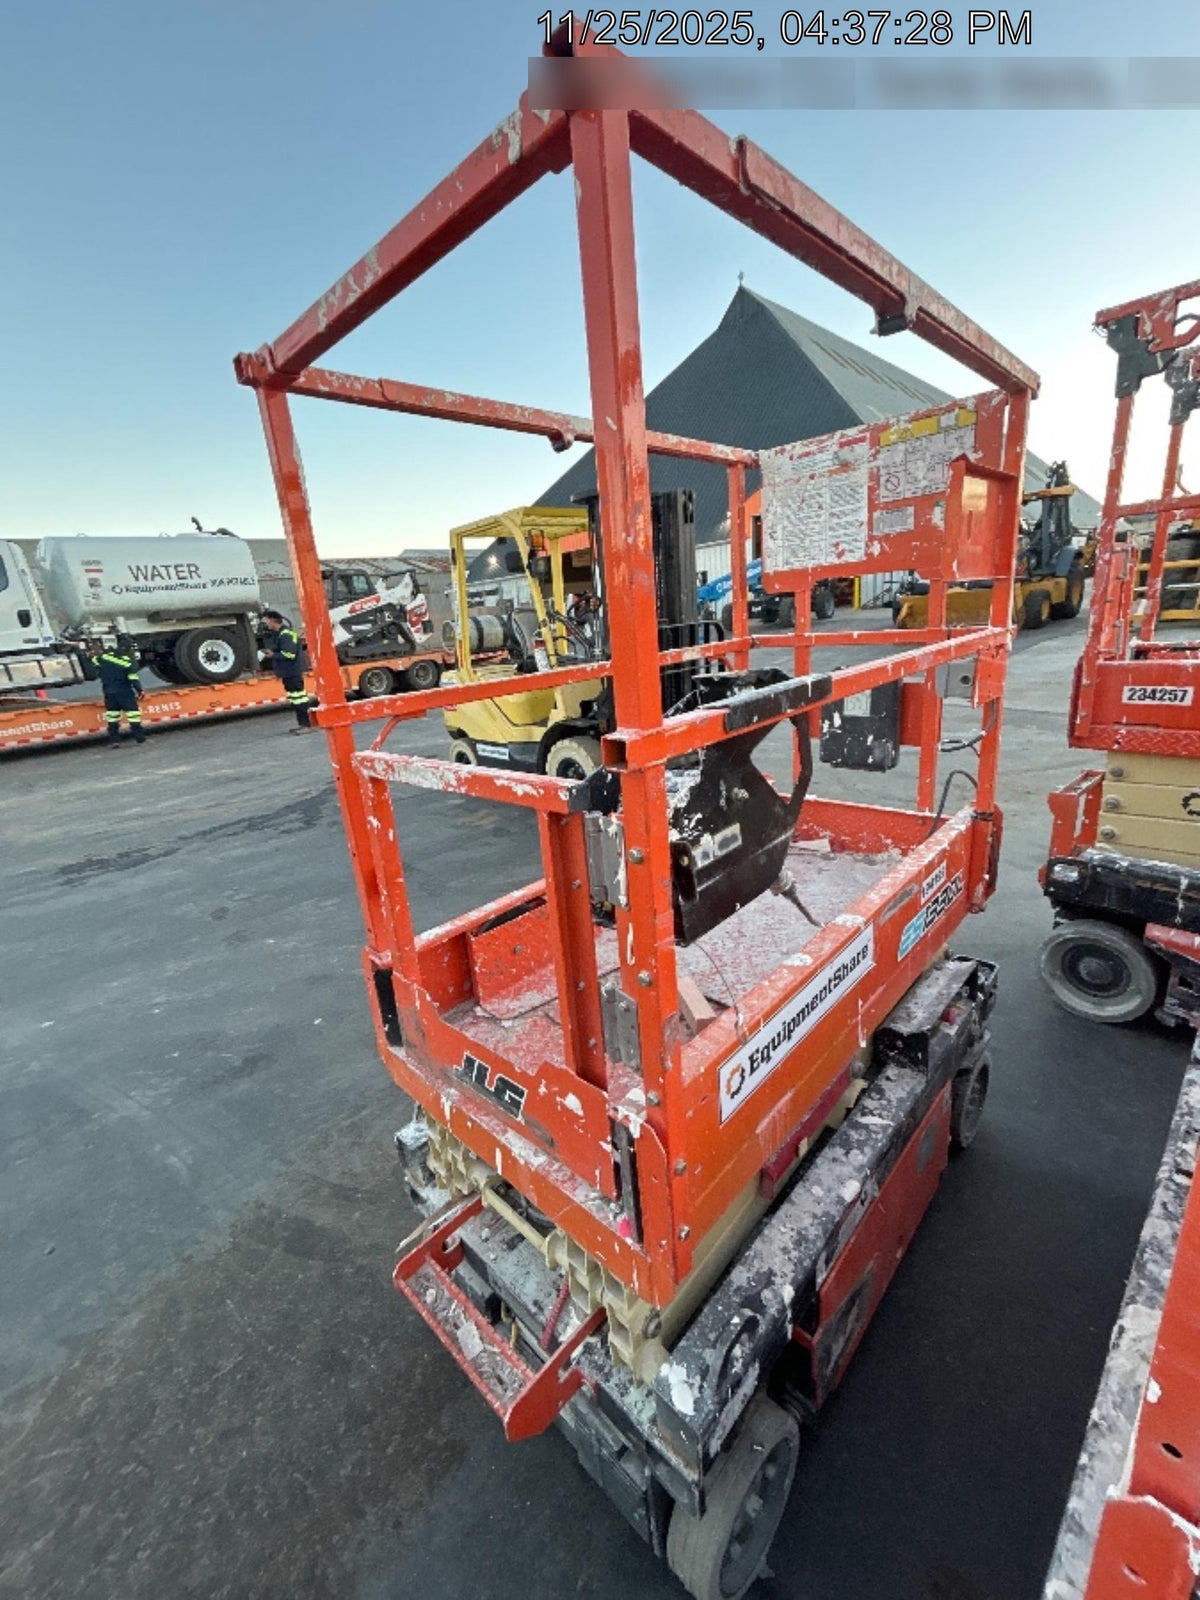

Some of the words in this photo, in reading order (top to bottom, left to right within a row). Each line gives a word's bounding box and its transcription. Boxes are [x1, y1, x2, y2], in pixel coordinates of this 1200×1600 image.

[127, 563, 202, 581] WATER
[1127, 688, 1188, 703] 234257
[748, 943, 869, 1077] EquipmentShare
[454, 1051, 528, 1123] JLG
